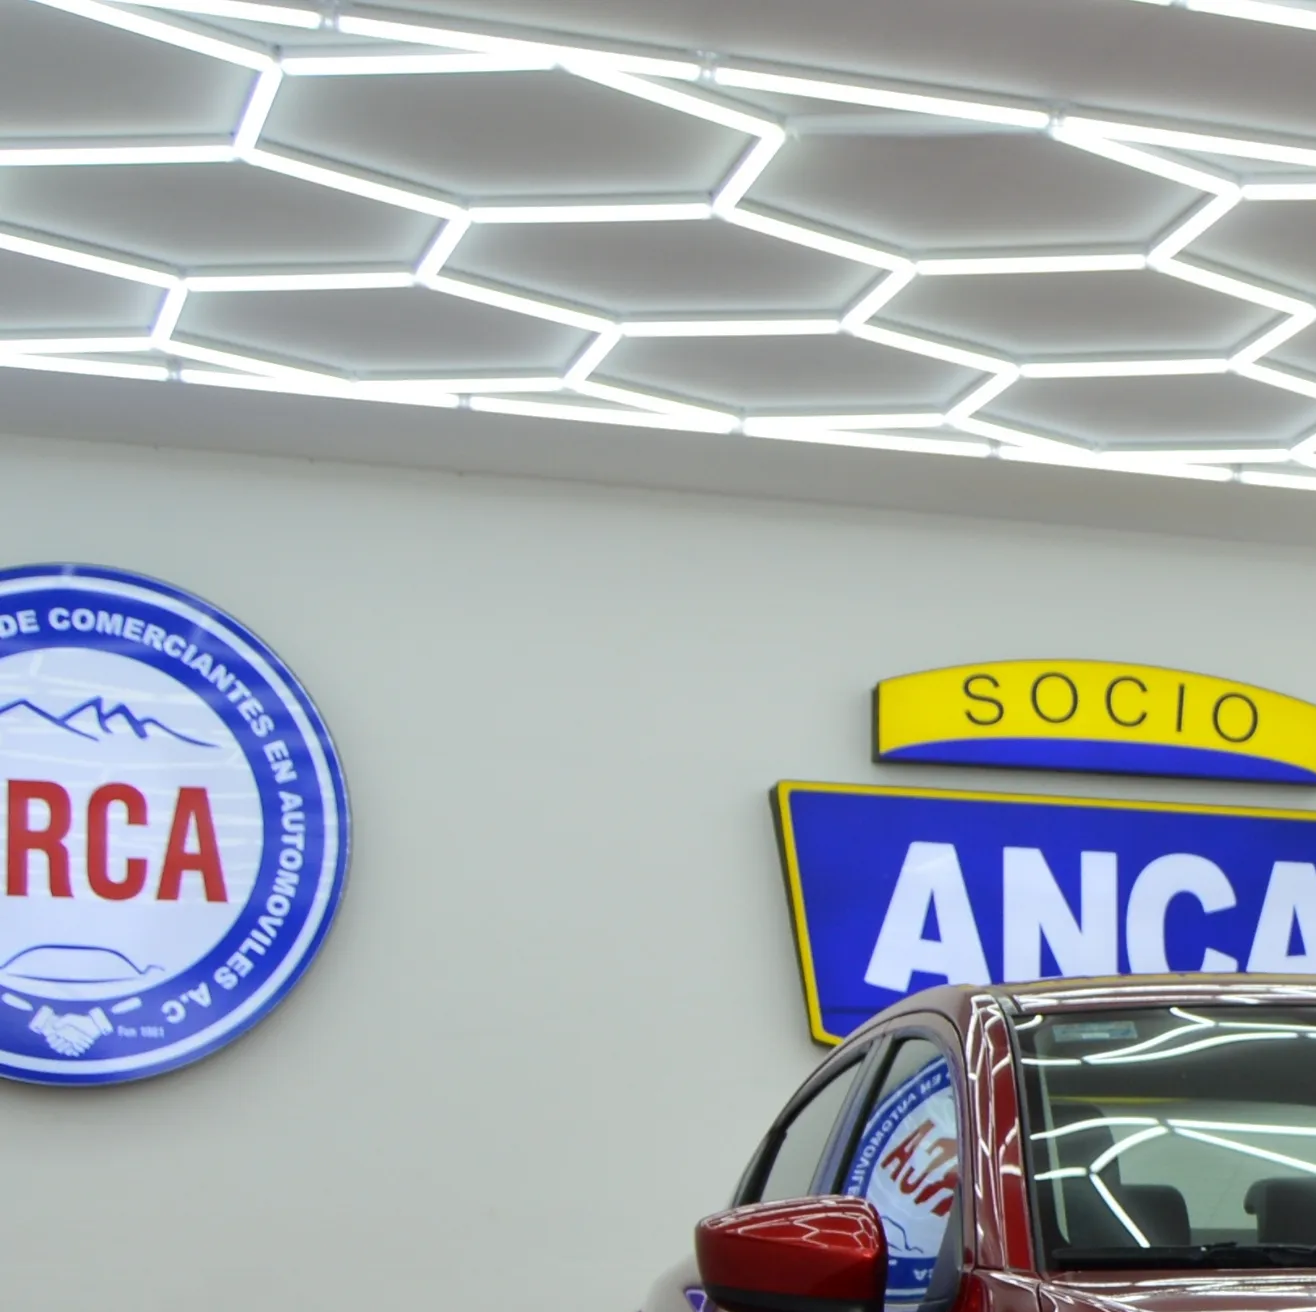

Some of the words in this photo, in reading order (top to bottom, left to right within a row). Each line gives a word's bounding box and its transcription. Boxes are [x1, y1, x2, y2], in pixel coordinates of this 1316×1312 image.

[0, 608, 41, 638] DE
[48, 606, 274, 738] COMERCIANTES
[963, 672, 1259, 743] SOCIO
[263, 740, 298, 784] EN
[7, 779, 228, 903] RCA
[213, 790, 306, 990] AUTOMOVILES
